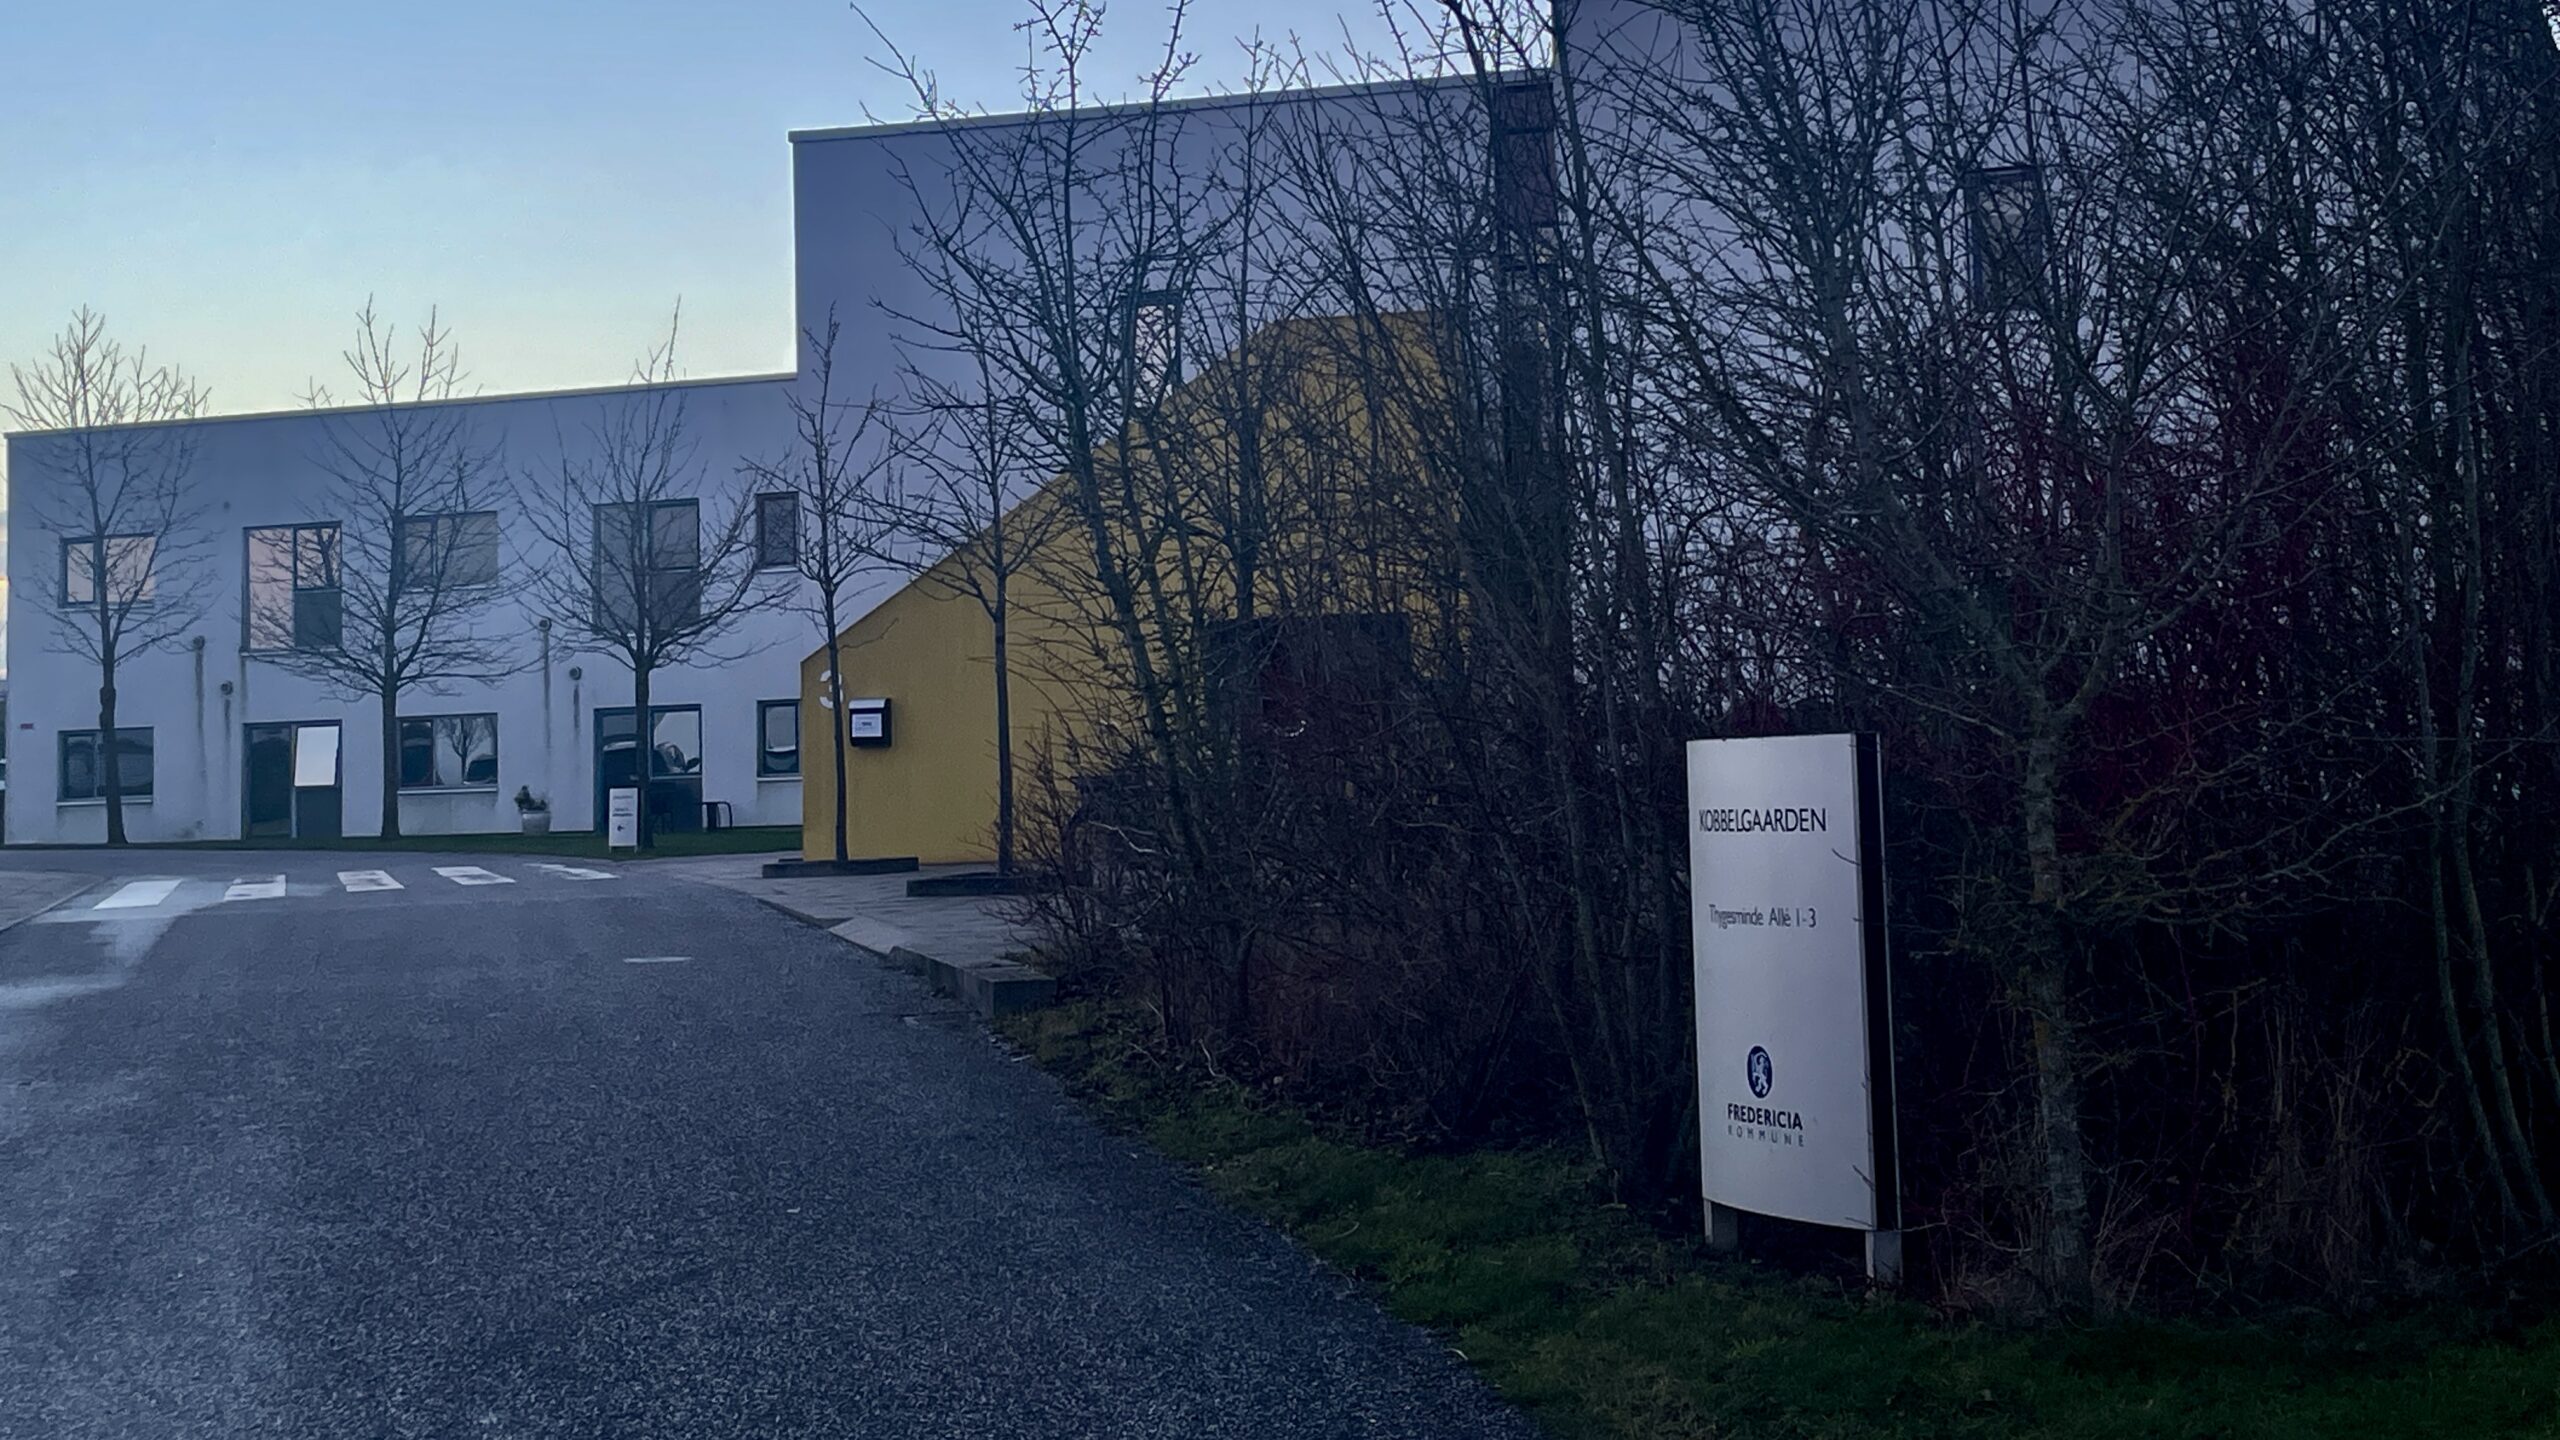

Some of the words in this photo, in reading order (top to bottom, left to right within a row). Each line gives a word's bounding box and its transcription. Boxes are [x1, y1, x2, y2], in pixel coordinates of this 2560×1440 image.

[1699, 808, 1827, 832] KOBBELGAARDEN
[1727, 1102, 1803, 1131] FREDERICIA
[1727, 1124, 1804, 1147] KOMMUNE
